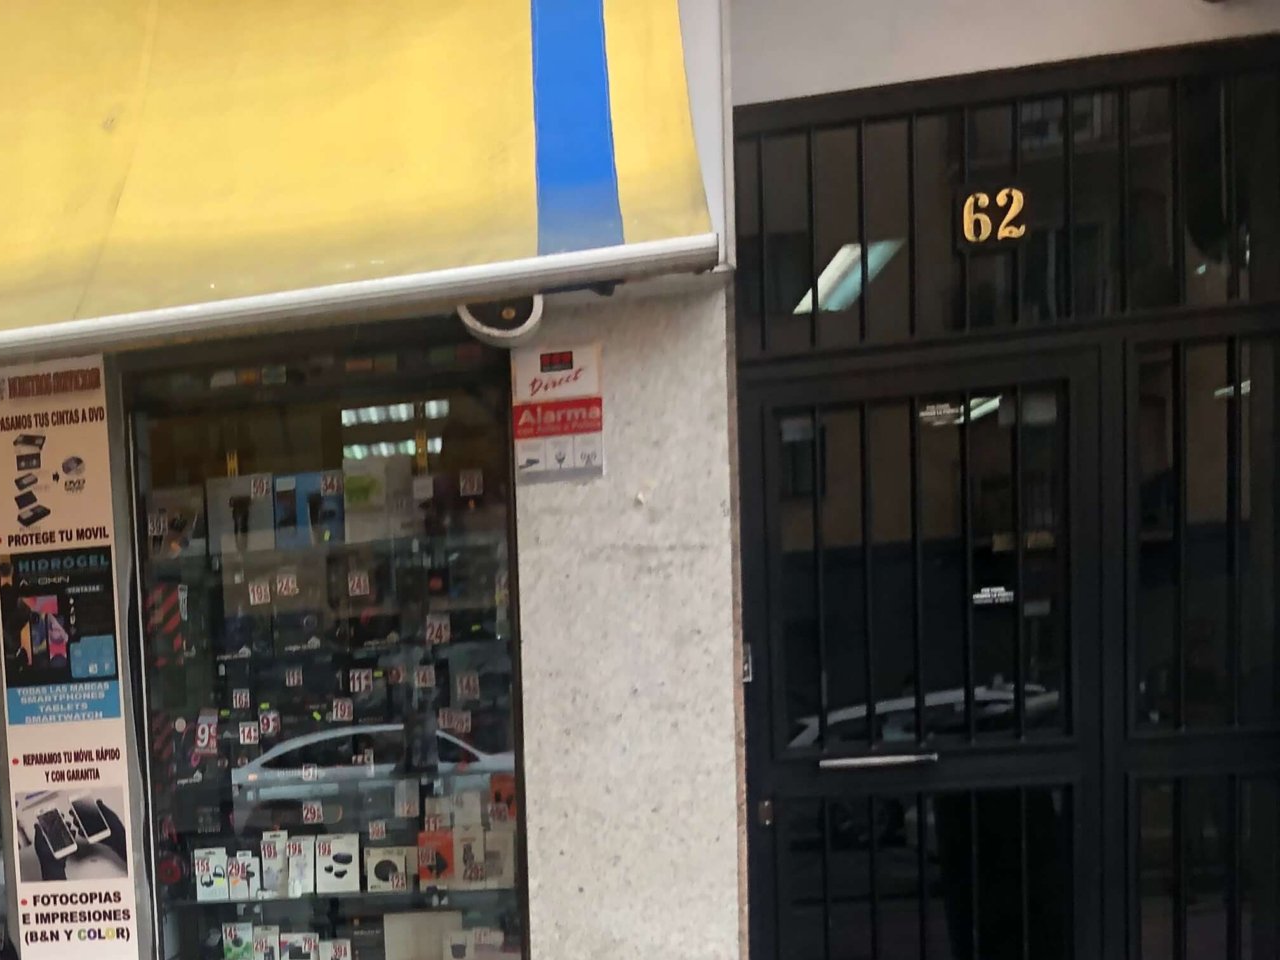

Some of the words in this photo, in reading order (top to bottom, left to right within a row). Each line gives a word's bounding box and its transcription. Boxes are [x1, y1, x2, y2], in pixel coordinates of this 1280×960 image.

[963, 187, 1026, 242] 62
[33, 411, 49, 429] TUS
[51, 409, 79, 426] CINTAS
[81, 409, 88, 422] A
[89, 406, 105, 422] DVD
[518, 405, 600, 426] Alarma
[8, 531, 56, 547] PROTEGE
[59, 530, 73, 542] TU
[76, 526, 109, 540] MOVIL
[18, 554, 110, 573] HIDROGEL
[17, 686, 47, 697] TODAS
[50, 685, 67, 693] LAS
[70, 682, 110, 692] MARCAS
[21, 690, 106, 704] SMARTPHONES
[40, 702, 88, 713] TABLETS
[25, 710, 103, 724] SMARTWATCH
[23, 751, 62, 766] REPARAMOS
[63, 751, 72, 763] TU
[74, 748, 94, 762] MÓVIL
[96, 747, 120, 761] RÁPIDO
[45, 771, 50, 782] Y
[51, 770, 66, 782] CON
[67, 767, 100, 781] GARANTIA
[33, 891, 121, 907] FOTOCOPIAS
[22, 913, 31, 925] E
[36, 908, 131, 924] IMPRESIONES
[25, 929, 60, 946] (B&N
[64, 929, 73, 941] Y
[78, 926, 130, 942] COLOR)
